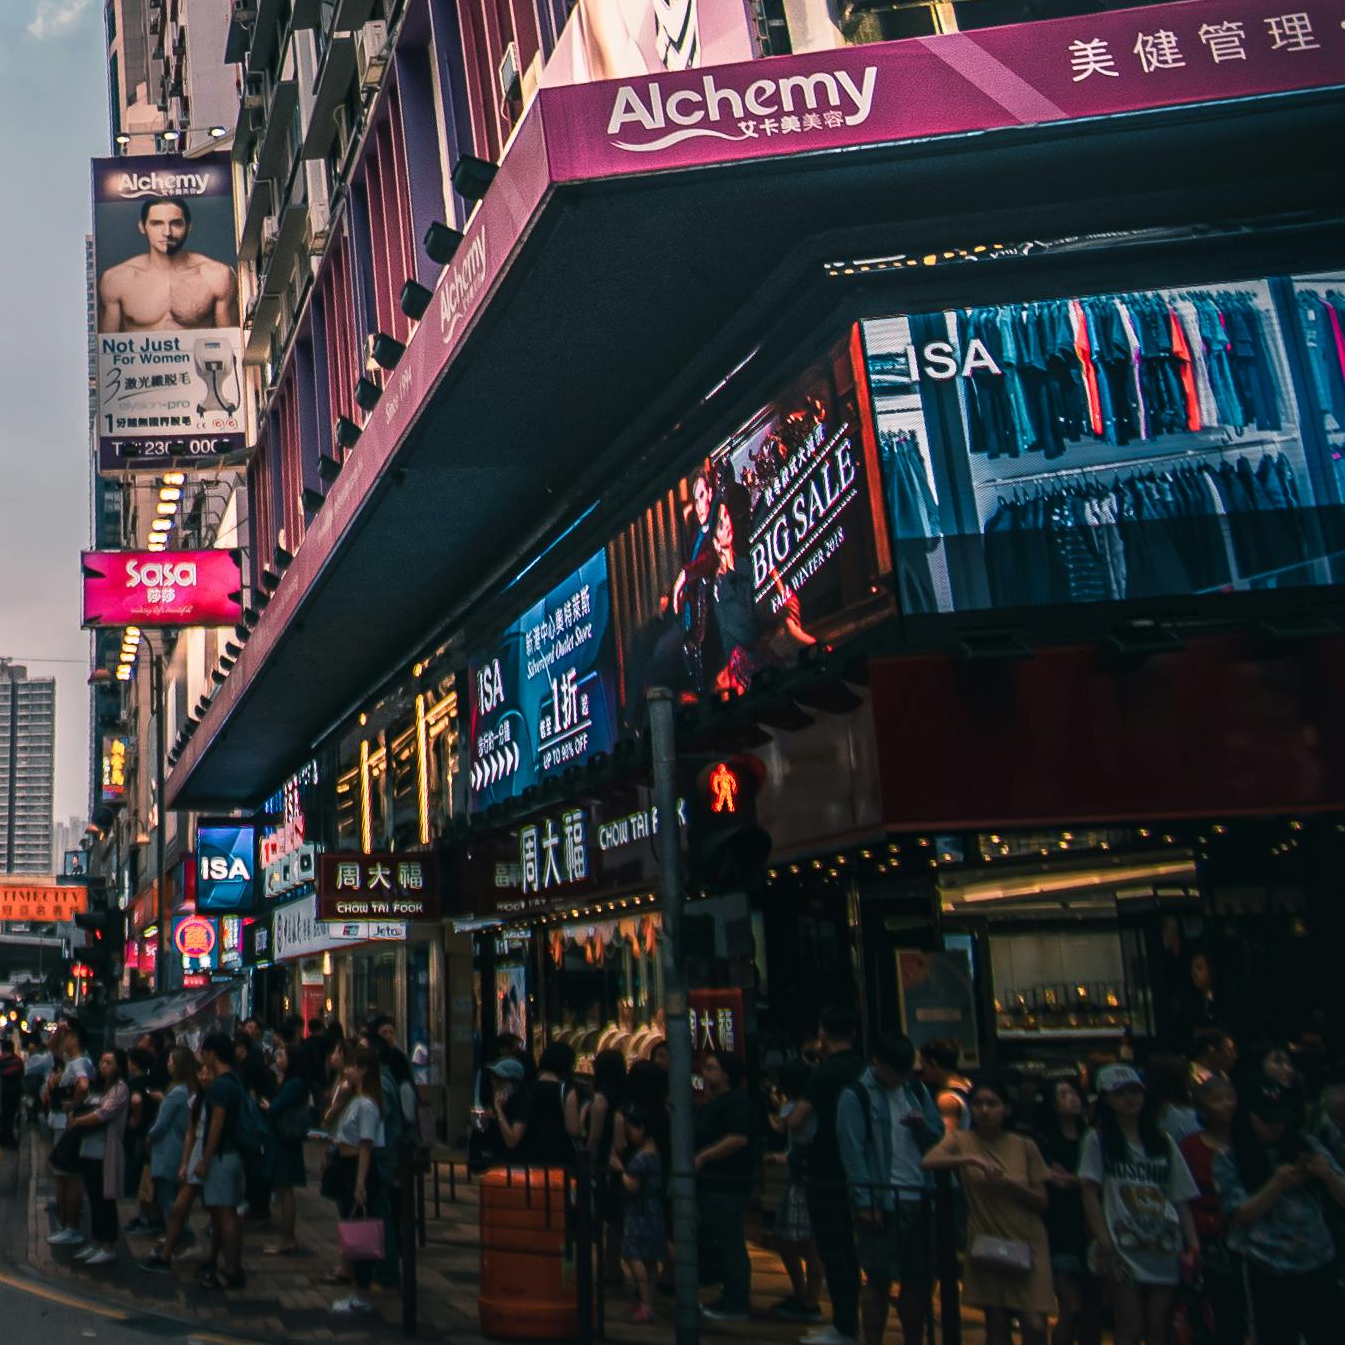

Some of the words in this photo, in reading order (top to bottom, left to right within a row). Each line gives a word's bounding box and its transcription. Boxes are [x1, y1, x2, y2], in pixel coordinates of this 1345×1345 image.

[1068, 12, 1321, 82] 美健管理
[606, 66, 878, 134] Alchemy
[118, 172, 209, 195] Alchemy
[440, 224, 486, 333] Alchemy
[102, 339, 134, 353] Not
[140, 337, 180, 353] Just
[113, 355, 136, 365] For
[140, 353, 190, 364] Women
[906, 338, 1002, 382] ISA
[750, 514, 789, 589] BIG
[792, 438, 855, 543] SALE
[126, 558, 196, 587] Sasa
[791, 548, 825, 591] WINTER
[477, 658, 505, 716] ISA
[543, 749, 552, 770] UP
[552, 746, 561, 764] TO
[574, 732, 589, 756] OFF
[599, 821, 628, 850] CHOW
[630, 813, 650, 841] TAI
[651, 798, 686, 834] FK
[201, 857, 251, 881] ISA
[520, 808, 588, 894] 周大福
[336, 862, 423, 890] 周大福
[336, 902, 368, 914] CHOW
[371, 902, 389, 913] TAI
[393, 901, 423, 913] FOOK
